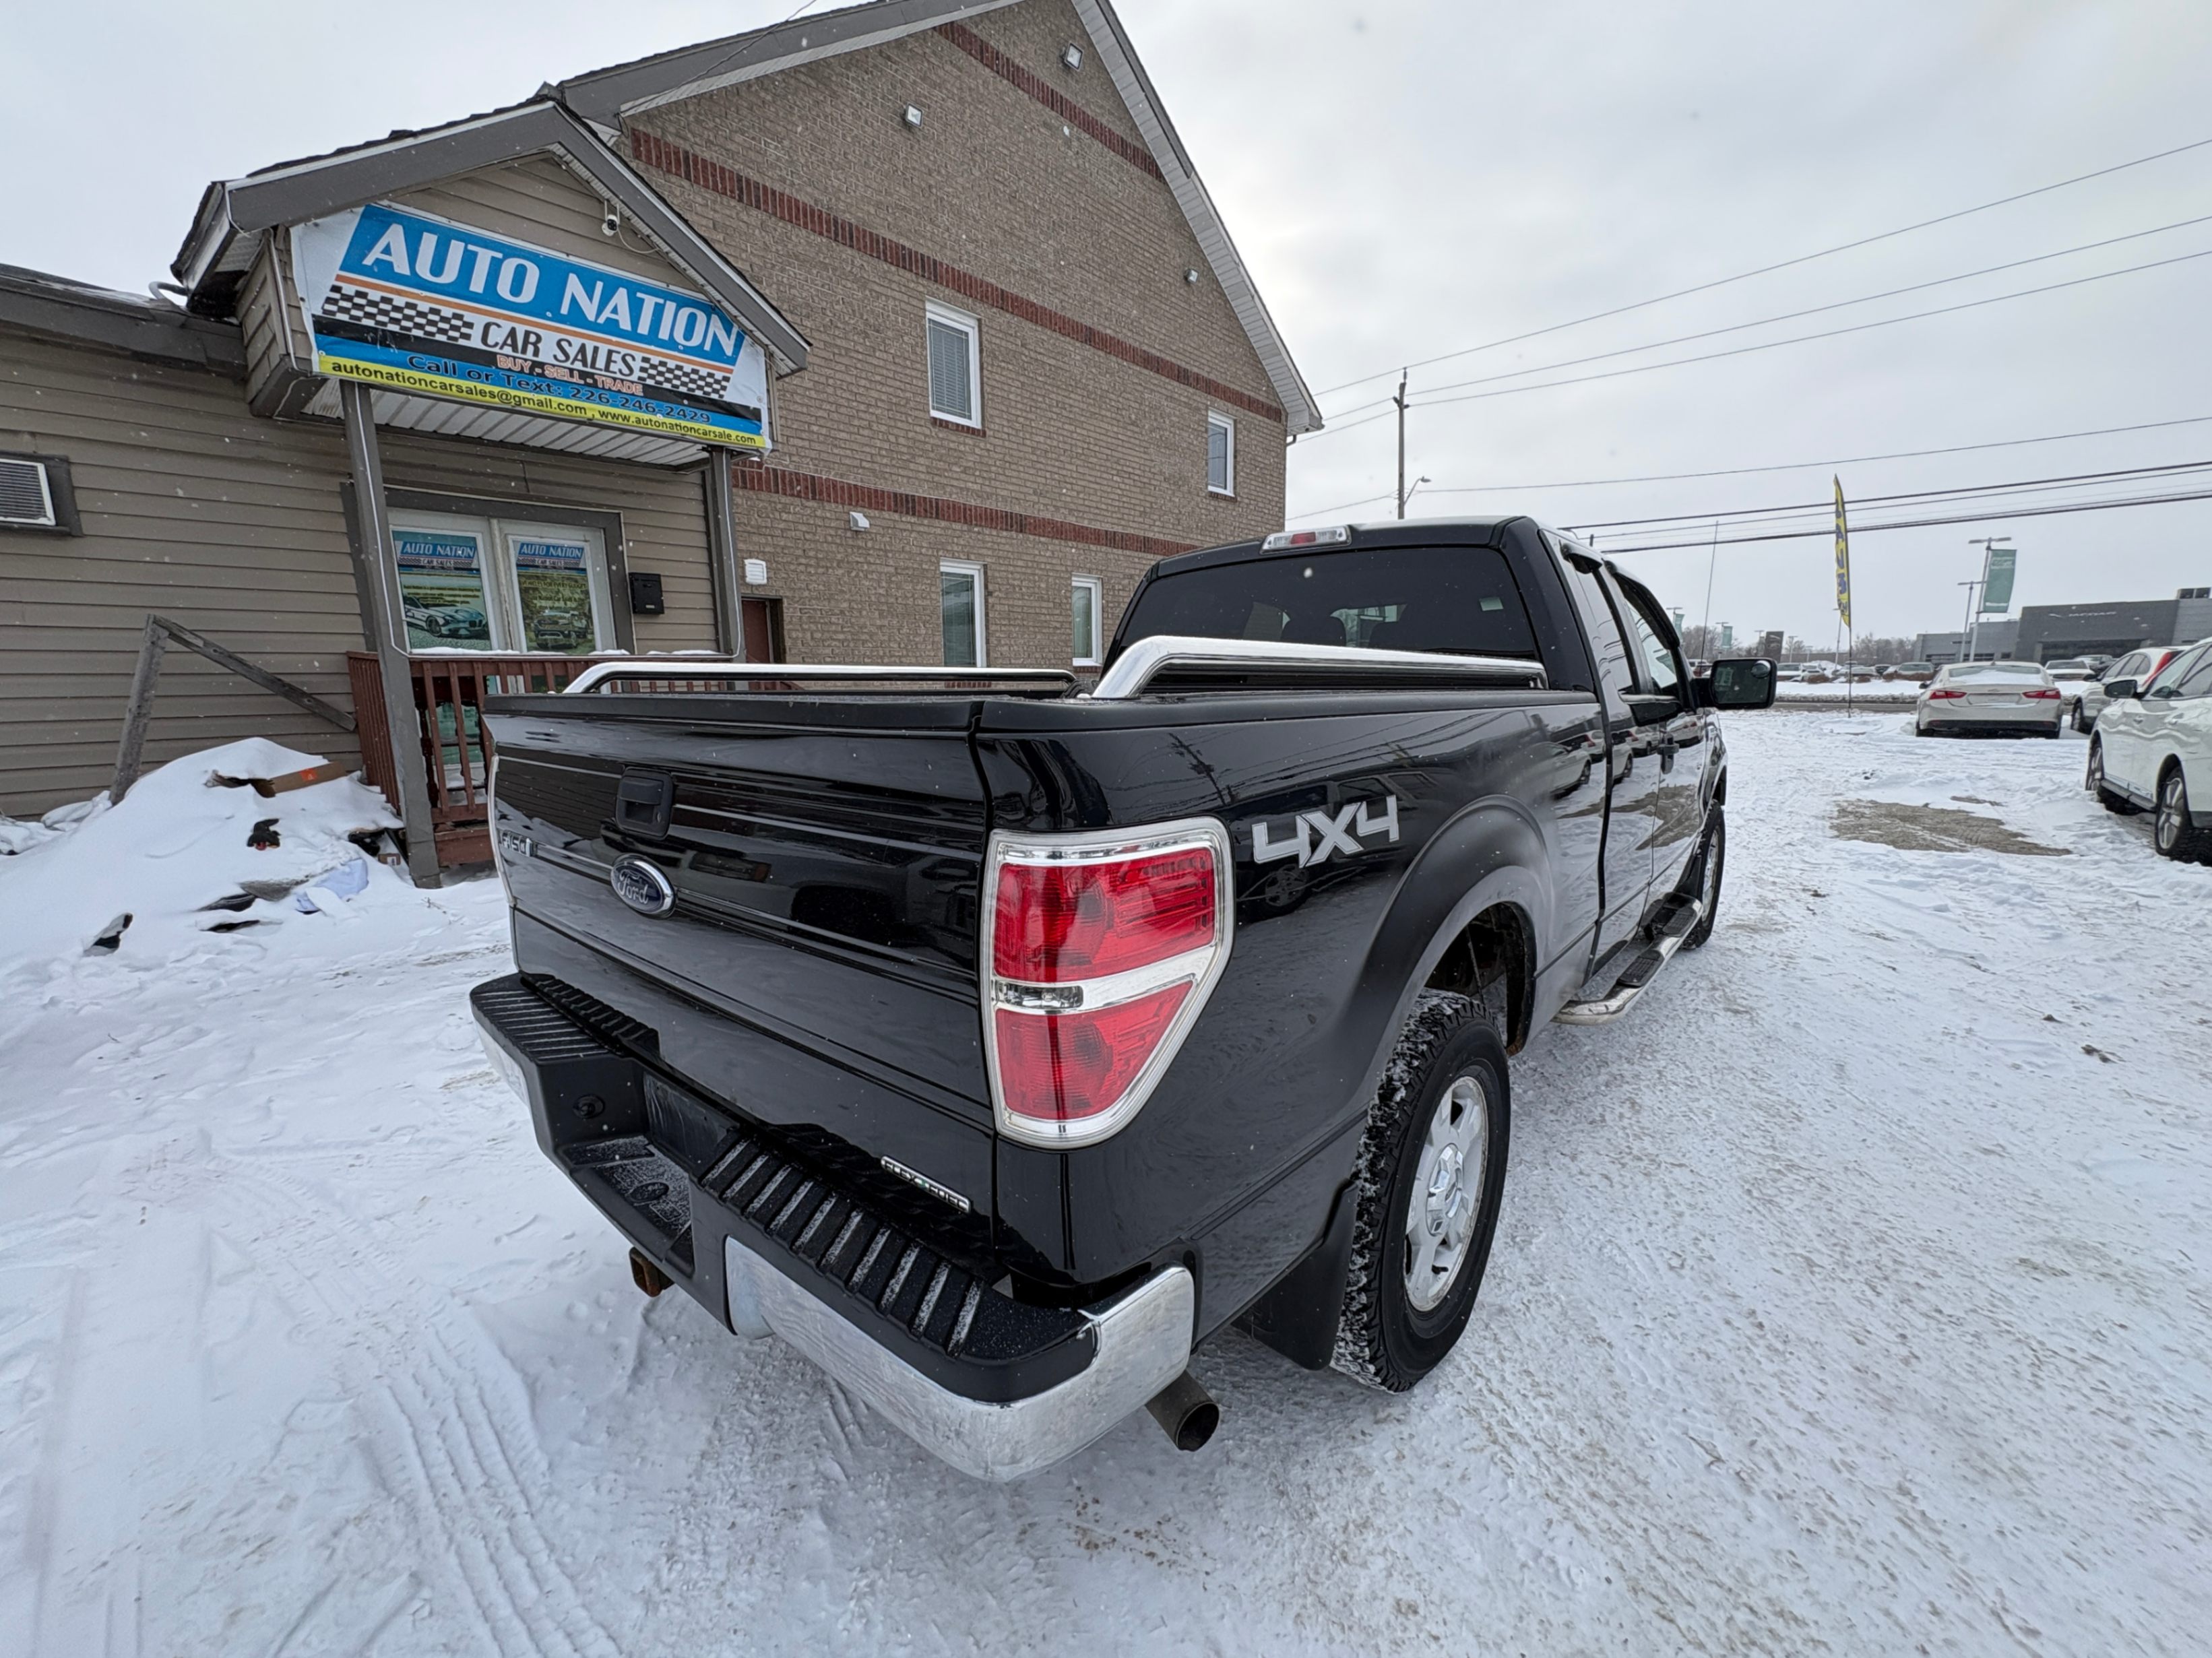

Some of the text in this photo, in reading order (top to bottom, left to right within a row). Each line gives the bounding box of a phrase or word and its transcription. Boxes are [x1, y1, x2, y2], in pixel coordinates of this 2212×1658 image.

[362, 223, 739, 356] AUTO NATION
[480, 321, 635, 377] CAR SALES
[407, 354, 712, 423] Call or Text: 226-246-2429
[497, 354, 532, 373] BUY
[544, 365, 584, 385] SELL
[594, 375, 643, 395] TRADE
[331, 360, 587, 416] autonationcarsales@gmail.com
[598, 409, 756, 445] www.autonationcarsale.com
[404, 543, 474, 558] AUTO NATION
[521, 544, 582, 558] AUTO NATION
[618, 868, 649, 905] Ford
